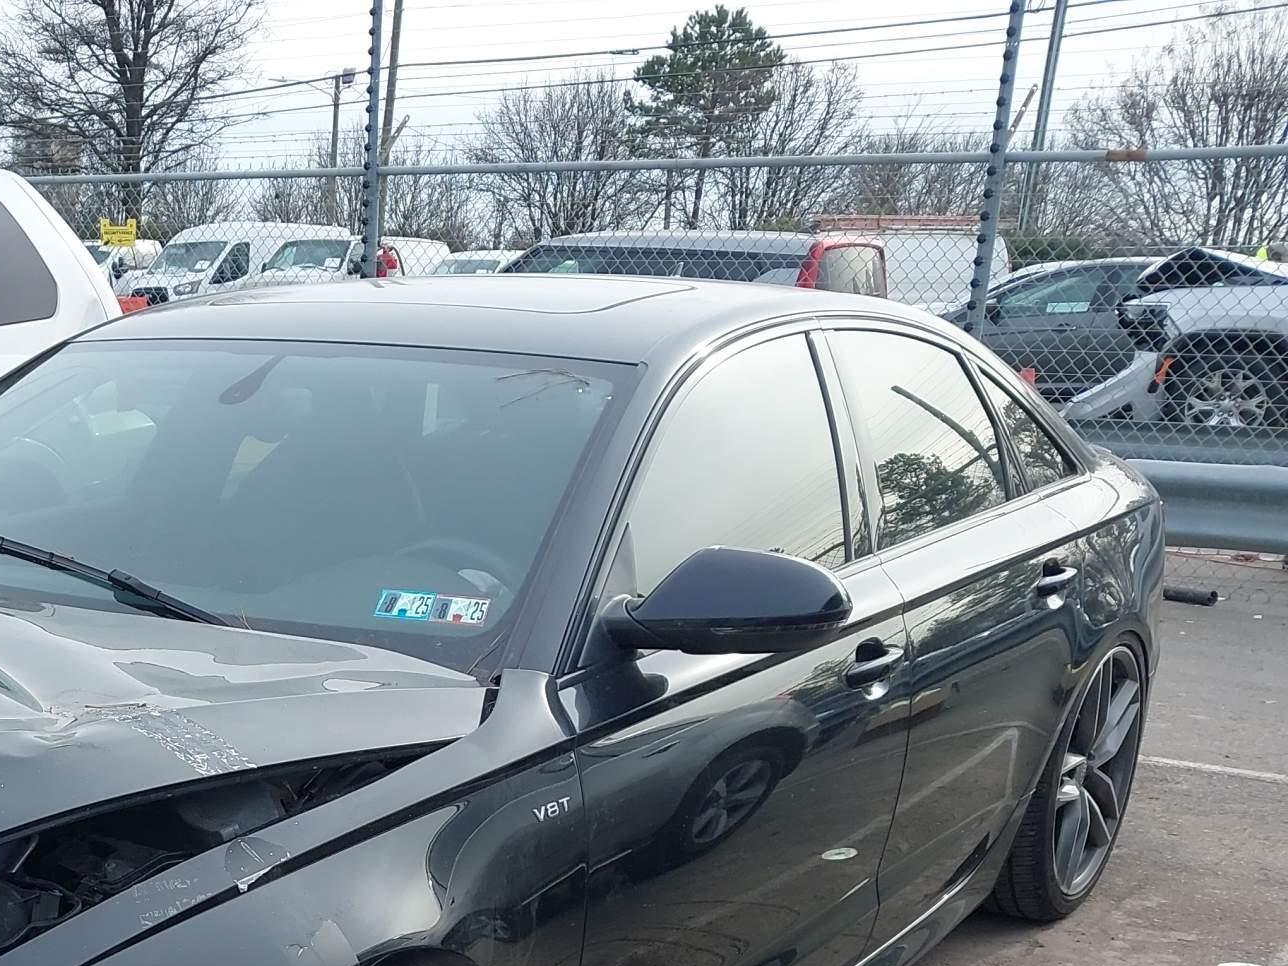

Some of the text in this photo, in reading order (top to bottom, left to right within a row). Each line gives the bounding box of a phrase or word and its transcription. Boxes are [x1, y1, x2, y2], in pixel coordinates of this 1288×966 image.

[415, 596, 432, 615] 25
[470, 601, 487, 621] 25
[532, 796, 571, 822] V8T
